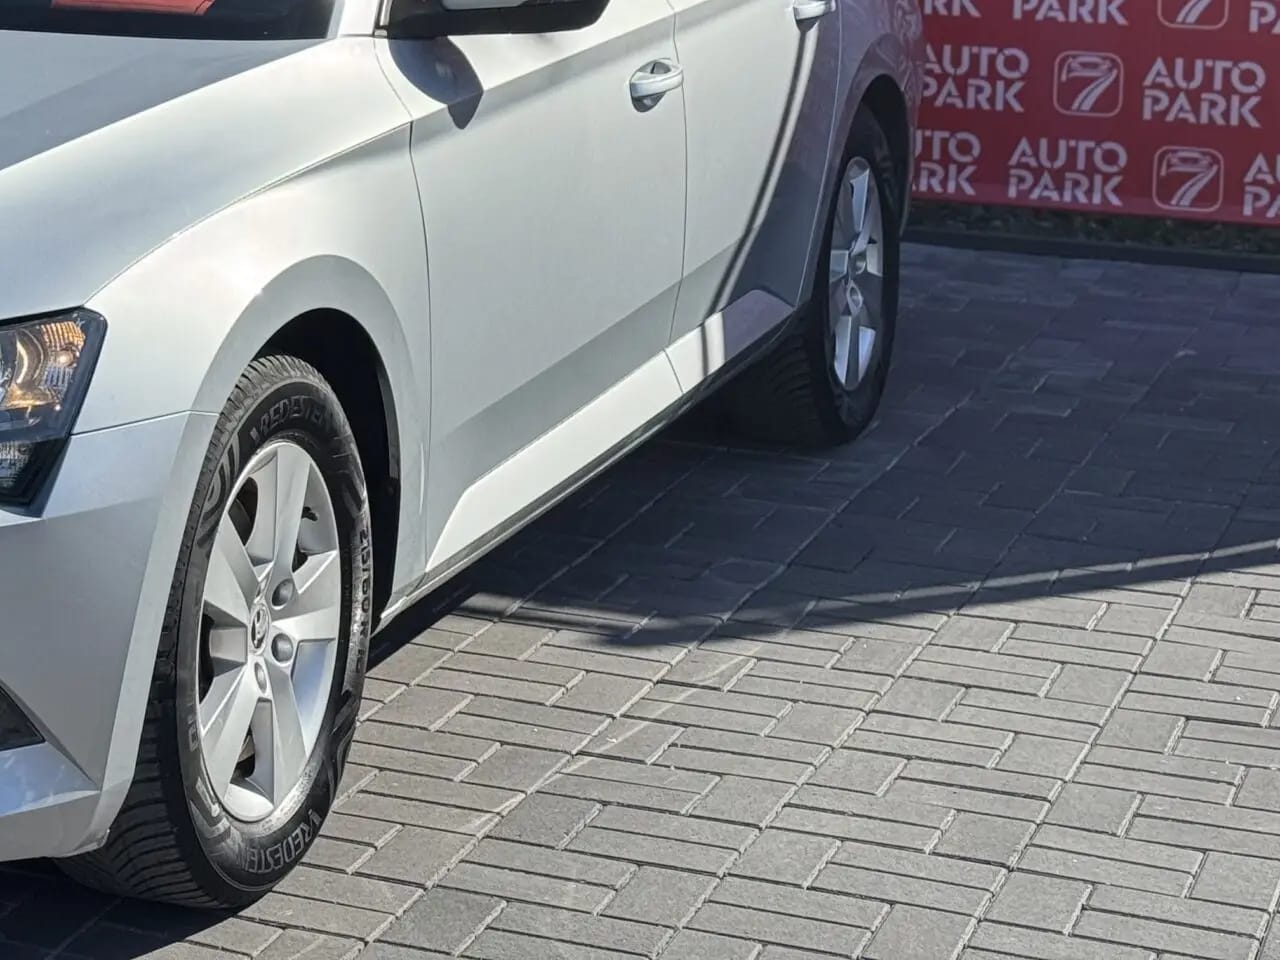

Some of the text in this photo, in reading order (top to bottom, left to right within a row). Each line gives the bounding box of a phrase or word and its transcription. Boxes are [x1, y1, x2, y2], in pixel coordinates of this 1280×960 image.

[1143, 57, 1266, 93] AUTO
[1143, 89, 1261, 127] PARK
[1008, 137, 1127, 173] AUTO
[1008, 169, 1123, 207] PARK
